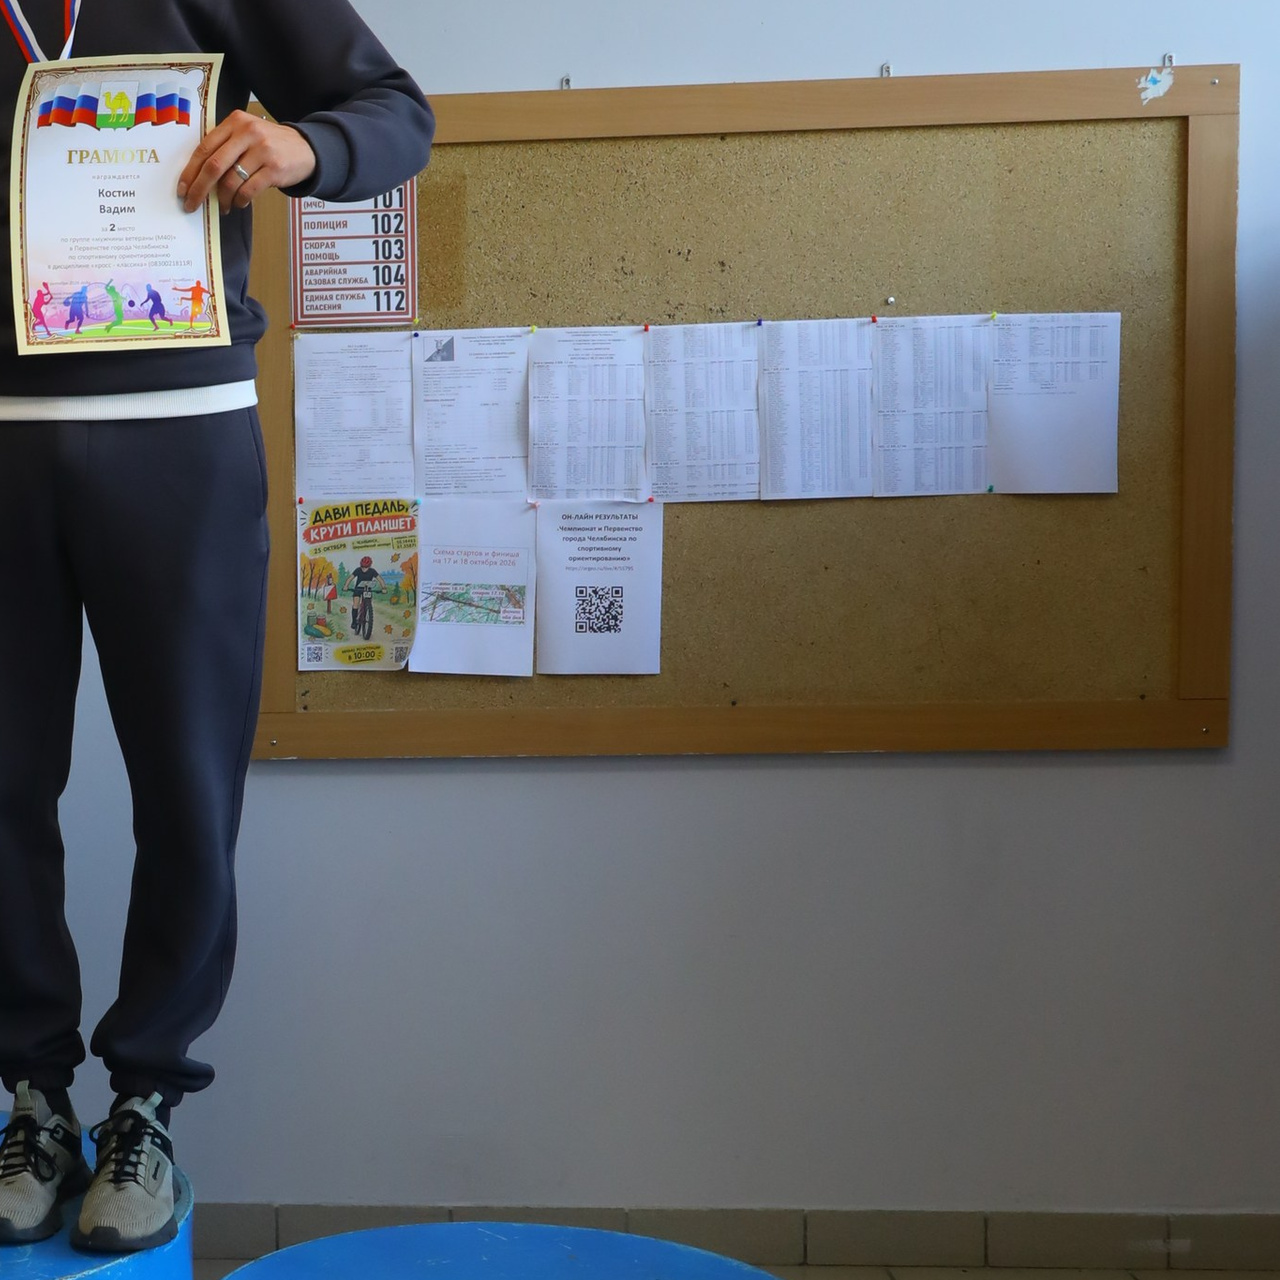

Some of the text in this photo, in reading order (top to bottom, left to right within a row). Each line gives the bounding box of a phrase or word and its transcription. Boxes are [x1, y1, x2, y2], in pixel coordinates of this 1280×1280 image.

[66, 148, 160, 164] ГРАМОТА
[98, 188, 136, 198] Костин
[373, 187, 404, 209] 101
[99, 204, 136, 216] Вадим
[304, 201, 326, 210] (МЧС)
[109, 224, 116, 232] 2
[304, 220, 348, 230] ПОЛИЦИЯ
[372, 213, 404, 234] 102
[304, 242, 336, 250] СКОРАЯ
[372, 238, 404, 260] 103
[304, 252, 340, 262] ПОМОЩЬ
[304, 266, 348, 276] АВАРИЙНАЯ
[372, 264, 405, 286] 104
[305, 294, 334, 302] ЕДИНАЯ
[374, 290, 405, 312] 112
[306, 304, 342, 312] СПАСЕНИЯ
[312, 500, 409, 525] ДАВИ ПЕДАЛЬ,
[562, 512, 594, 520] ОН-ЛАЙН
[310, 517, 412, 542] КРУТИ ПЛАНШЕТ
[323, 543, 347, 552] ОКТЯБРЯ
[491, 550, 520, 558] финиша
[469, 558, 498, 566] октября
[354, 650, 376, 660] 10:00
